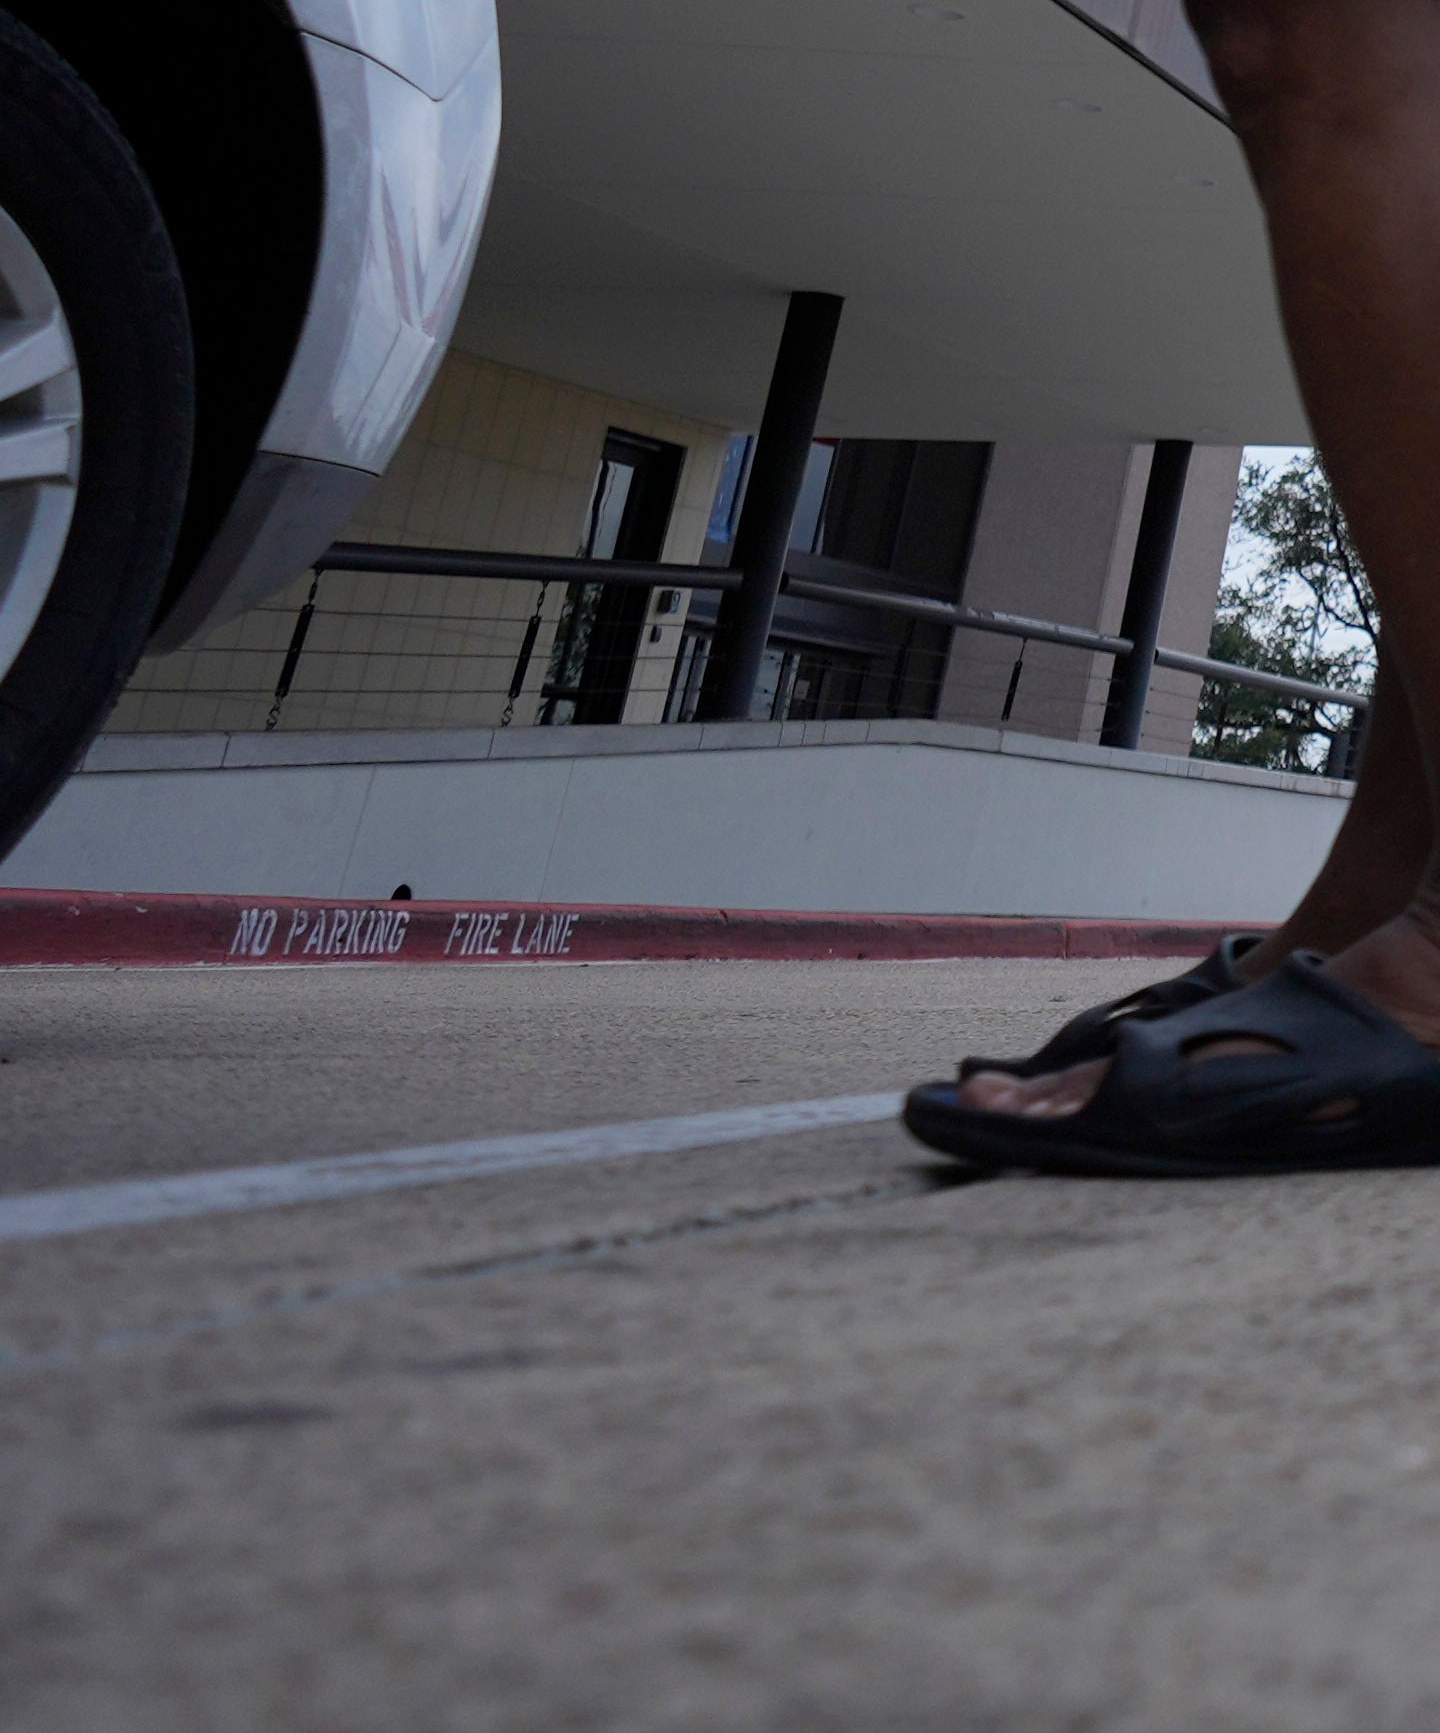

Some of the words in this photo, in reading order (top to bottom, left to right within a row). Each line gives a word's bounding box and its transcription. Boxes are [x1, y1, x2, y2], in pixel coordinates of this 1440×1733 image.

[230, 908, 277, 956] NO
[283, 908, 410, 955] PARKING
[445, 912, 508, 955] FIRE
[512, 913, 580, 955] LANE
